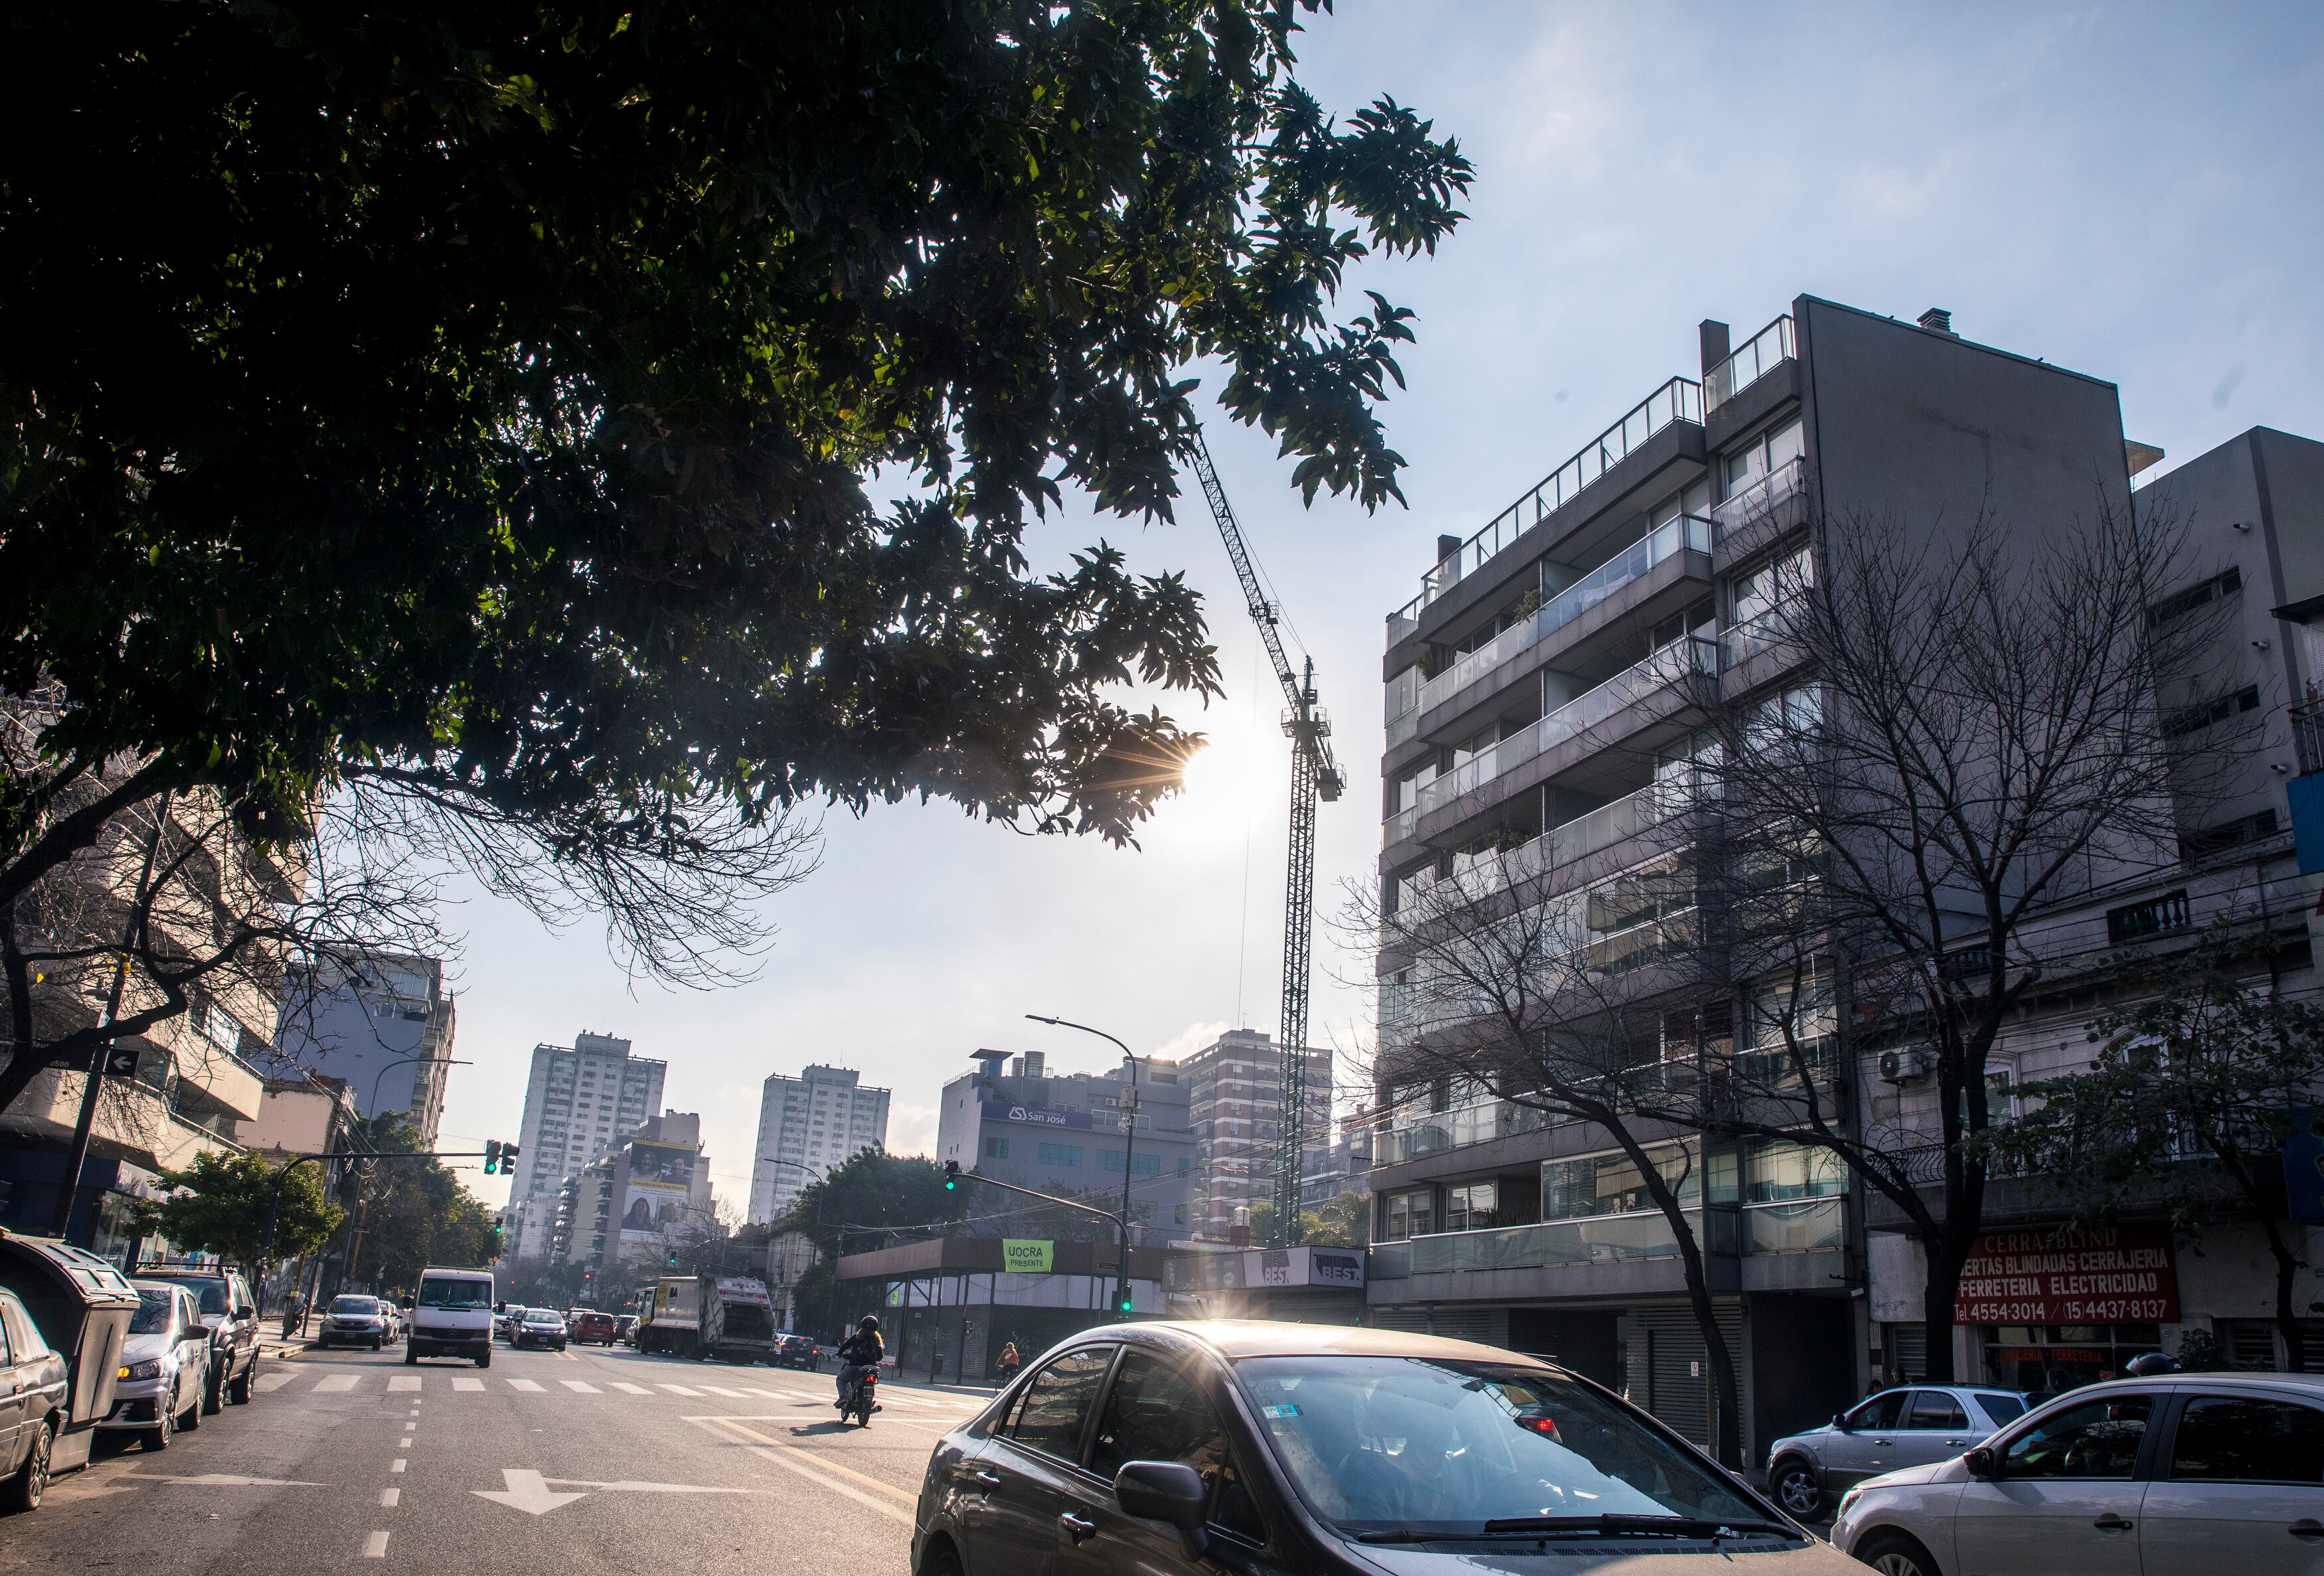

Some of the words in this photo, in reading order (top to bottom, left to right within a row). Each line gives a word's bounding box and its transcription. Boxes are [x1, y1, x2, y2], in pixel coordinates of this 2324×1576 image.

[1028, 1112, 1044, 1122] San
[1046, 1115, 1066, 1125] José
[1009, 1246, 1043, 1257] UOCRA
[2005, 1253, 2076, 1275] BLINDADAS
[2080, 1249, 2169, 1271] CERRAJERIA
[1265, 1267, 1289, 1285] BEST
[1323, 1266, 1360, 1281] BEST
[1960, 1277, 2041, 1297] FERRETERIA
[2050, 1273, 2157, 1295] ELECTRICIDAD
[1954, 1304, 1969, 1321] Tel.
[1971, 1302, 2045, 1320] 4554-3014
[2051, 1348, 2104, 1363] FERRETERIA
